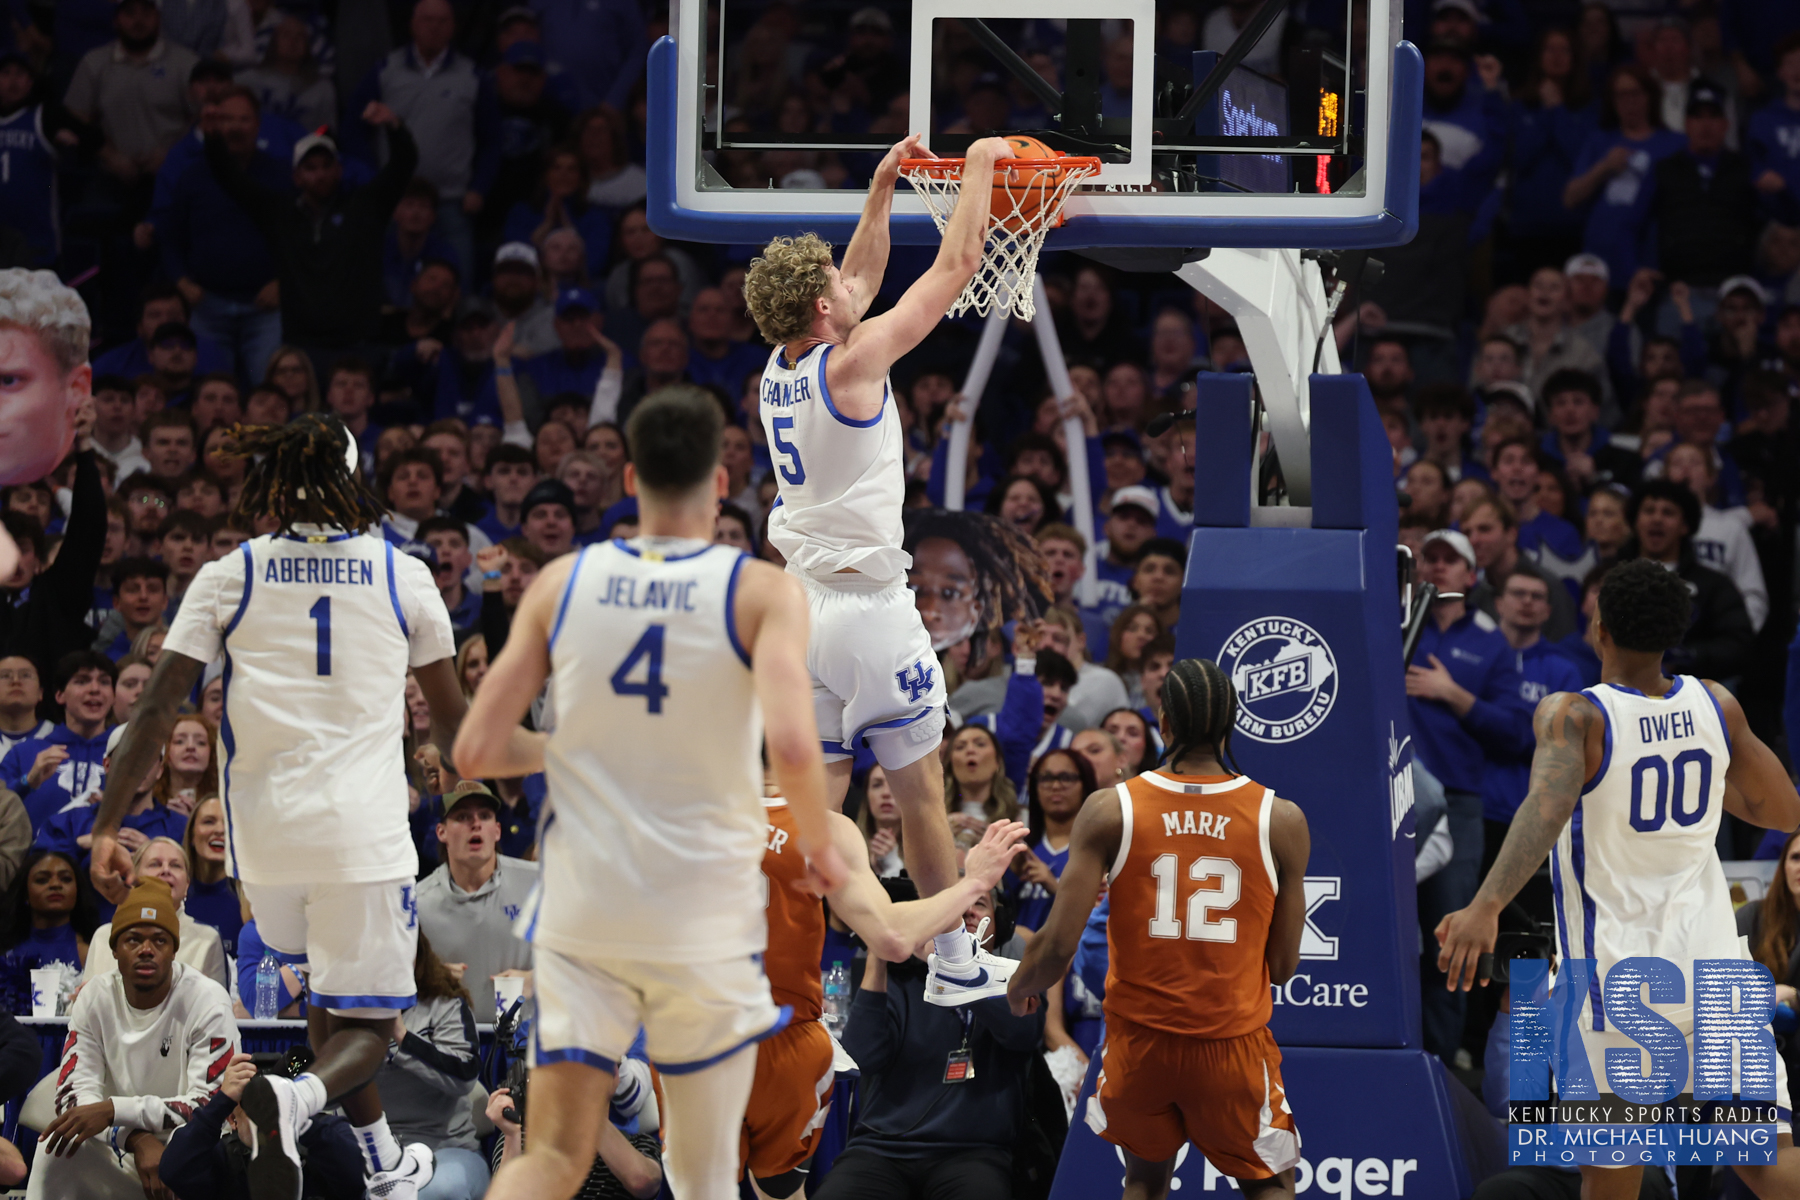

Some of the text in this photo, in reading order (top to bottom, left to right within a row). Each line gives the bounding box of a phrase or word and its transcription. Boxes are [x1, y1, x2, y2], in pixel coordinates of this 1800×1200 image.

[773, 416, 806, 485] 5
[265, 557, 373, 586] ABERDEEN
[309, 596, 331, 676] 1
[1226, 621, 1316, 658] KENTUCKY
[610, 622, 669, 715] 4
[1249, 660, 1306, 698] KFB
[1235, 691, 1331, 738] ARM BUREAU
[1639, 709, 1695, 743] OWEH
[1629, 748, 1712, 832] 00
[1161, 810, 1231, 840] MARK
[1149, 853, 1242, 944] 12
